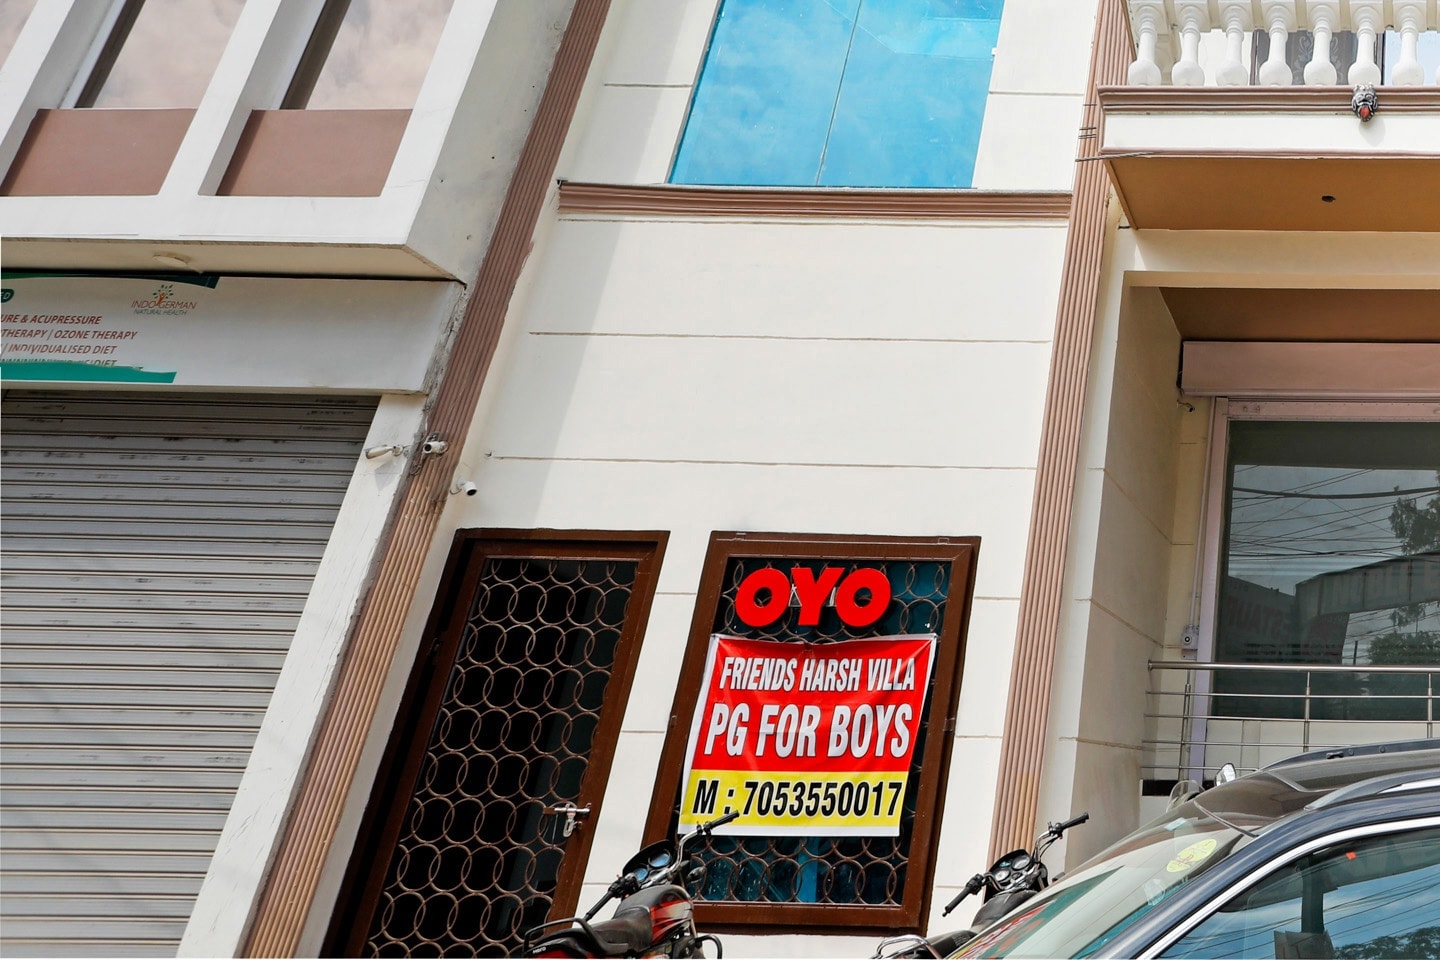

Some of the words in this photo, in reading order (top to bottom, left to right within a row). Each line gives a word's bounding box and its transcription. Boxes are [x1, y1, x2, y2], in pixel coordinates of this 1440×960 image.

[20, 314, 29, 324] &
[30, 315, 102, 325] ACUPRESSURE
[54, 329, 89, 340] OZONE
[91, 330, 138, 341] THERAPY
[8, 343, 91, 355] INDIVIDUALISED
[92, 345, 117, 355] DIET
[735, 567, 892, 628] OYO
[719, 656, 798, 691] FRIENDS
[799, 657, 863, 692] HARSH
[866, 657, 915, 692] VILLA
[703, 702, 750, 757] PG
[755, 704, 822, 758] FOR
[826, 703, 914, 758] BOYS
[742, 780, 903, 818] 7053550017
